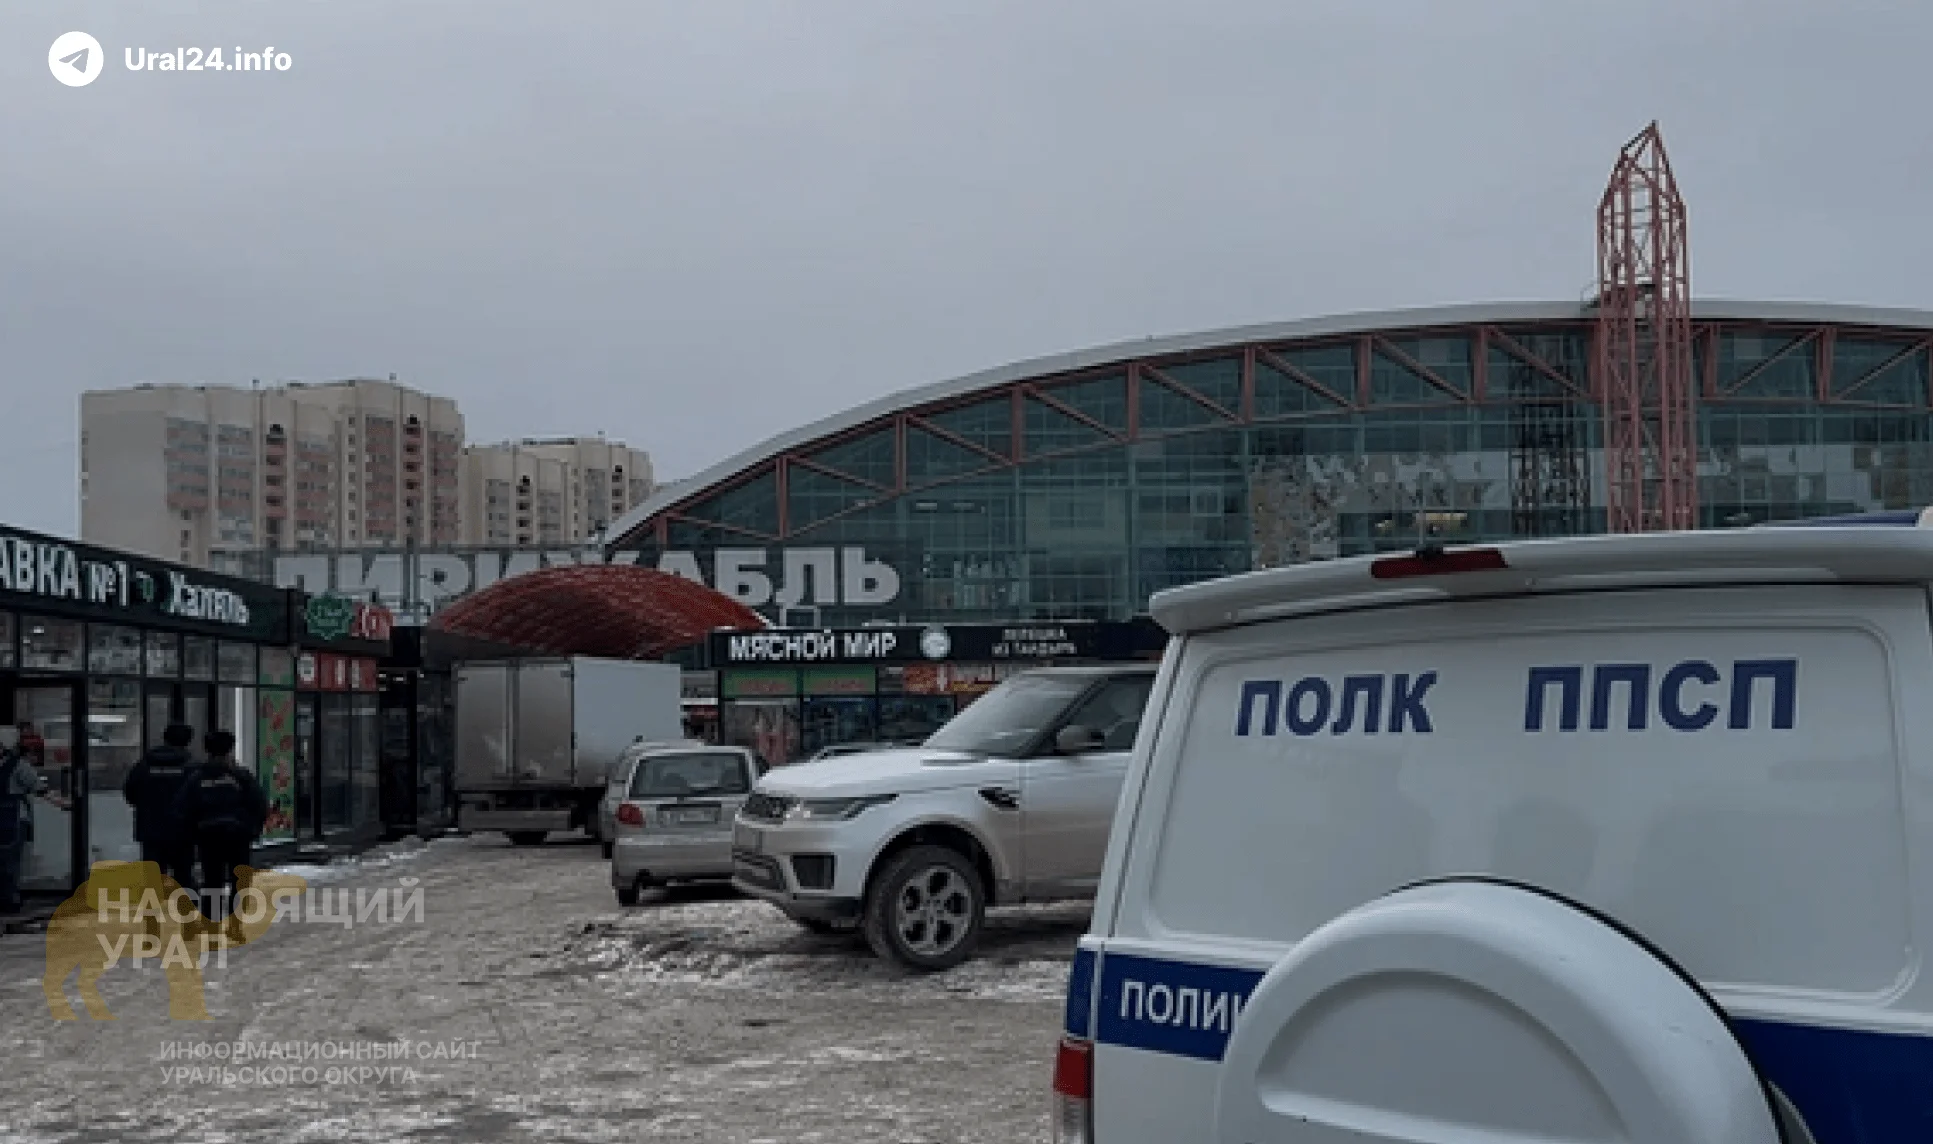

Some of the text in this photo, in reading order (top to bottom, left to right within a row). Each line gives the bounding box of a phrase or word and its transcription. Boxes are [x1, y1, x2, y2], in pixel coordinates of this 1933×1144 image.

[168, 570, 250, 626] Халяль
[729, 629, 897, 660] МЯСНОЙ МИР
[1234, 658, 1798, 737] ПОЛК ППСП
